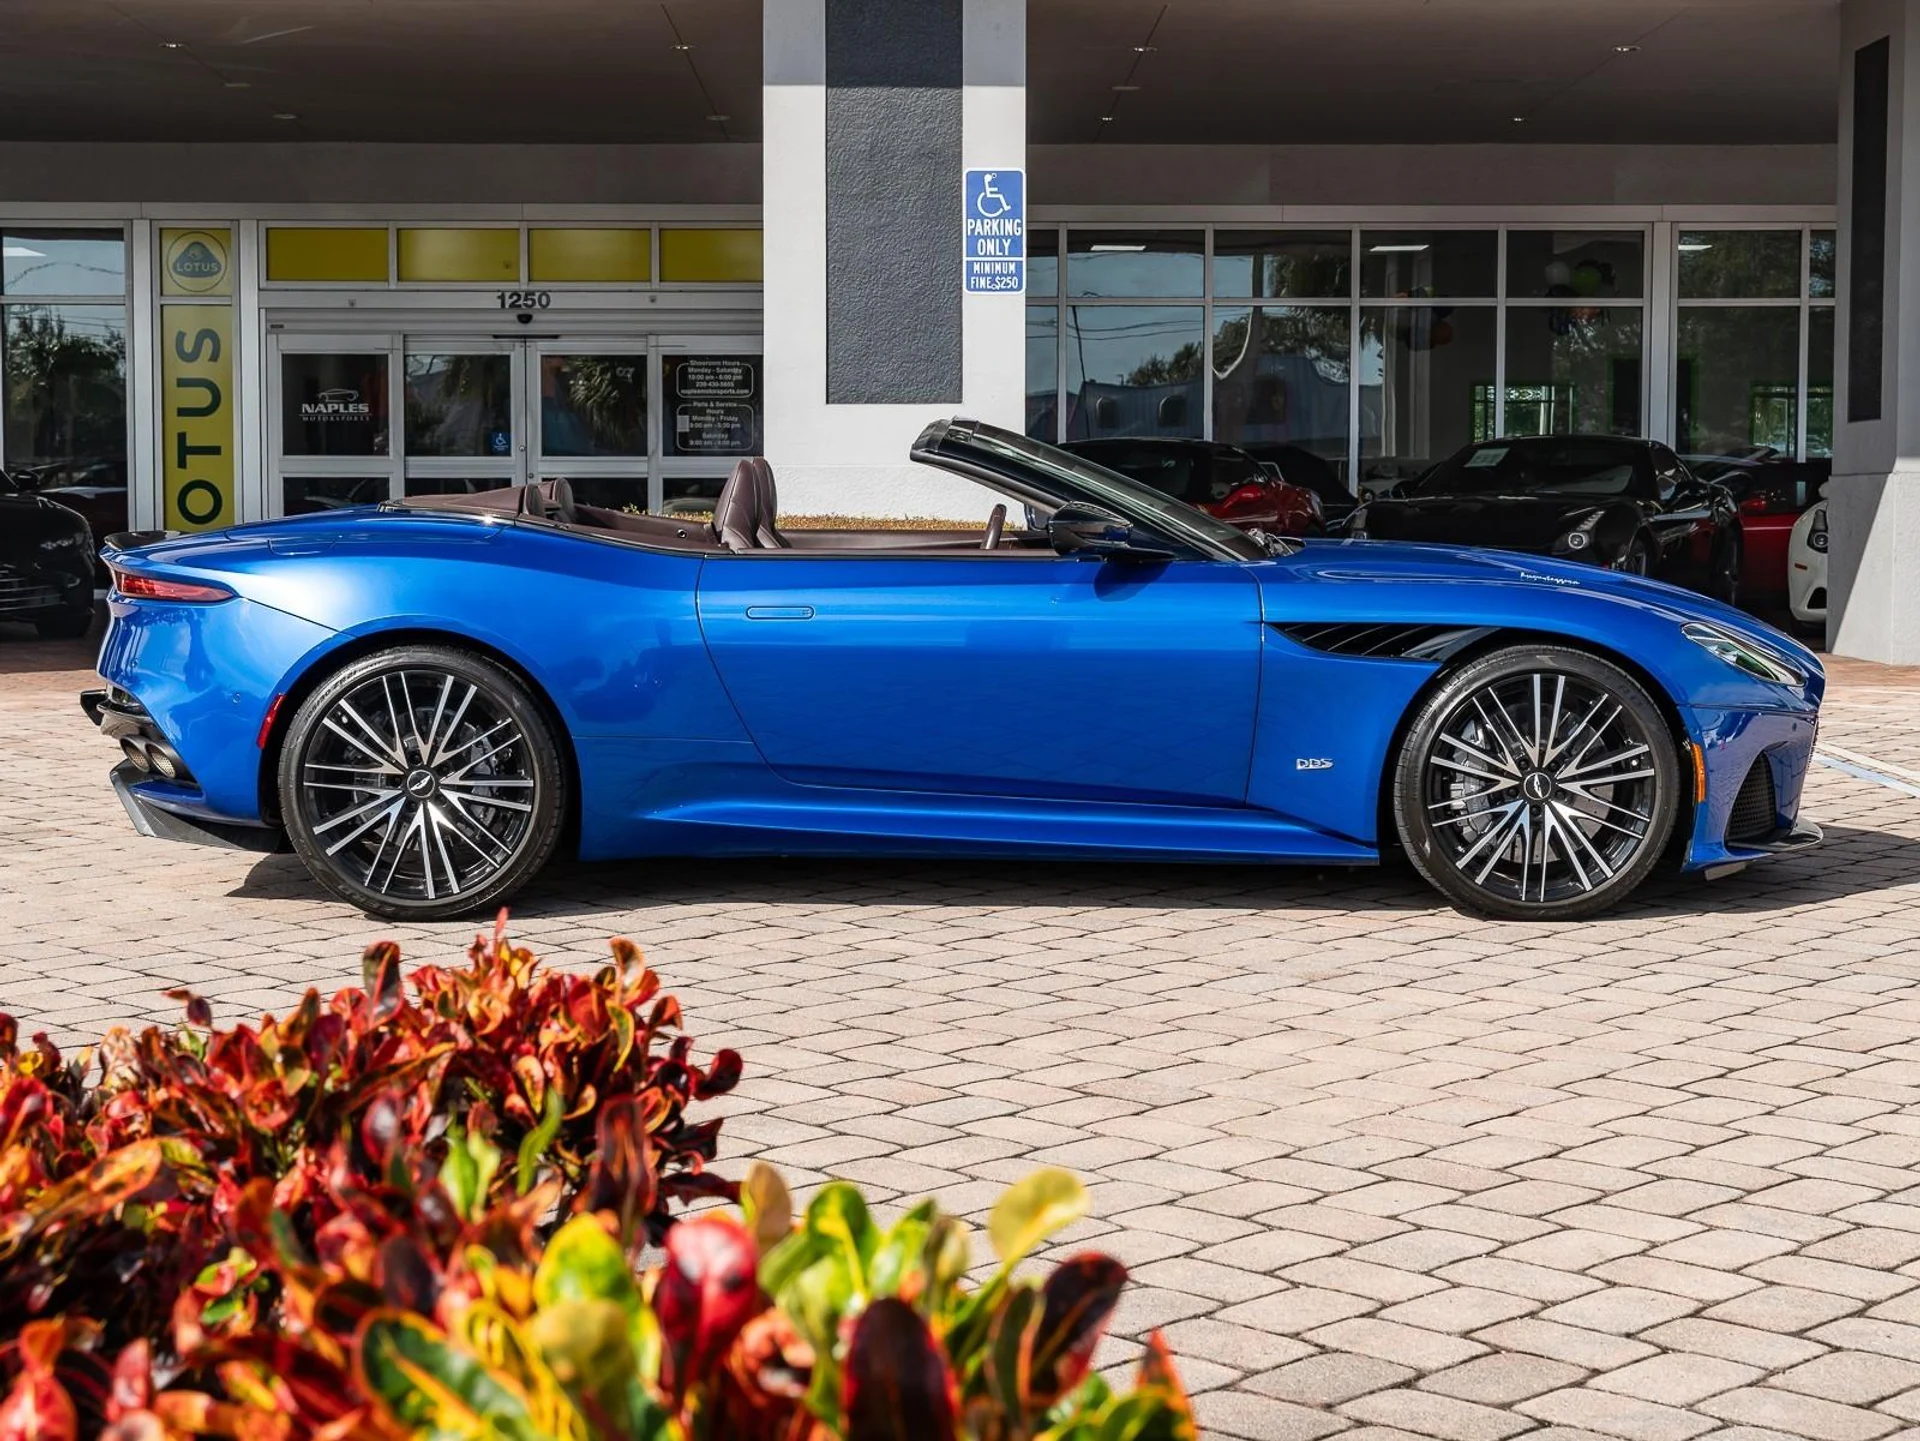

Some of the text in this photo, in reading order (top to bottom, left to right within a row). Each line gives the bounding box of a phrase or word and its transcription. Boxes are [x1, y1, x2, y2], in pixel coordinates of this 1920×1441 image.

[967, 218, 1022, 236] PARKING
[977, 238, 1012, 256] ONLY
[176, 261, 218, 272] LOTUS
[973, 261, 1016, 274] MINIMUM
[970, 276, 1019, 290] FINE $250
[496, 292, 551, 309] 1250
[302, 403, 370, 413] NAPLES
[175, 328, 223, 525] OTUS
